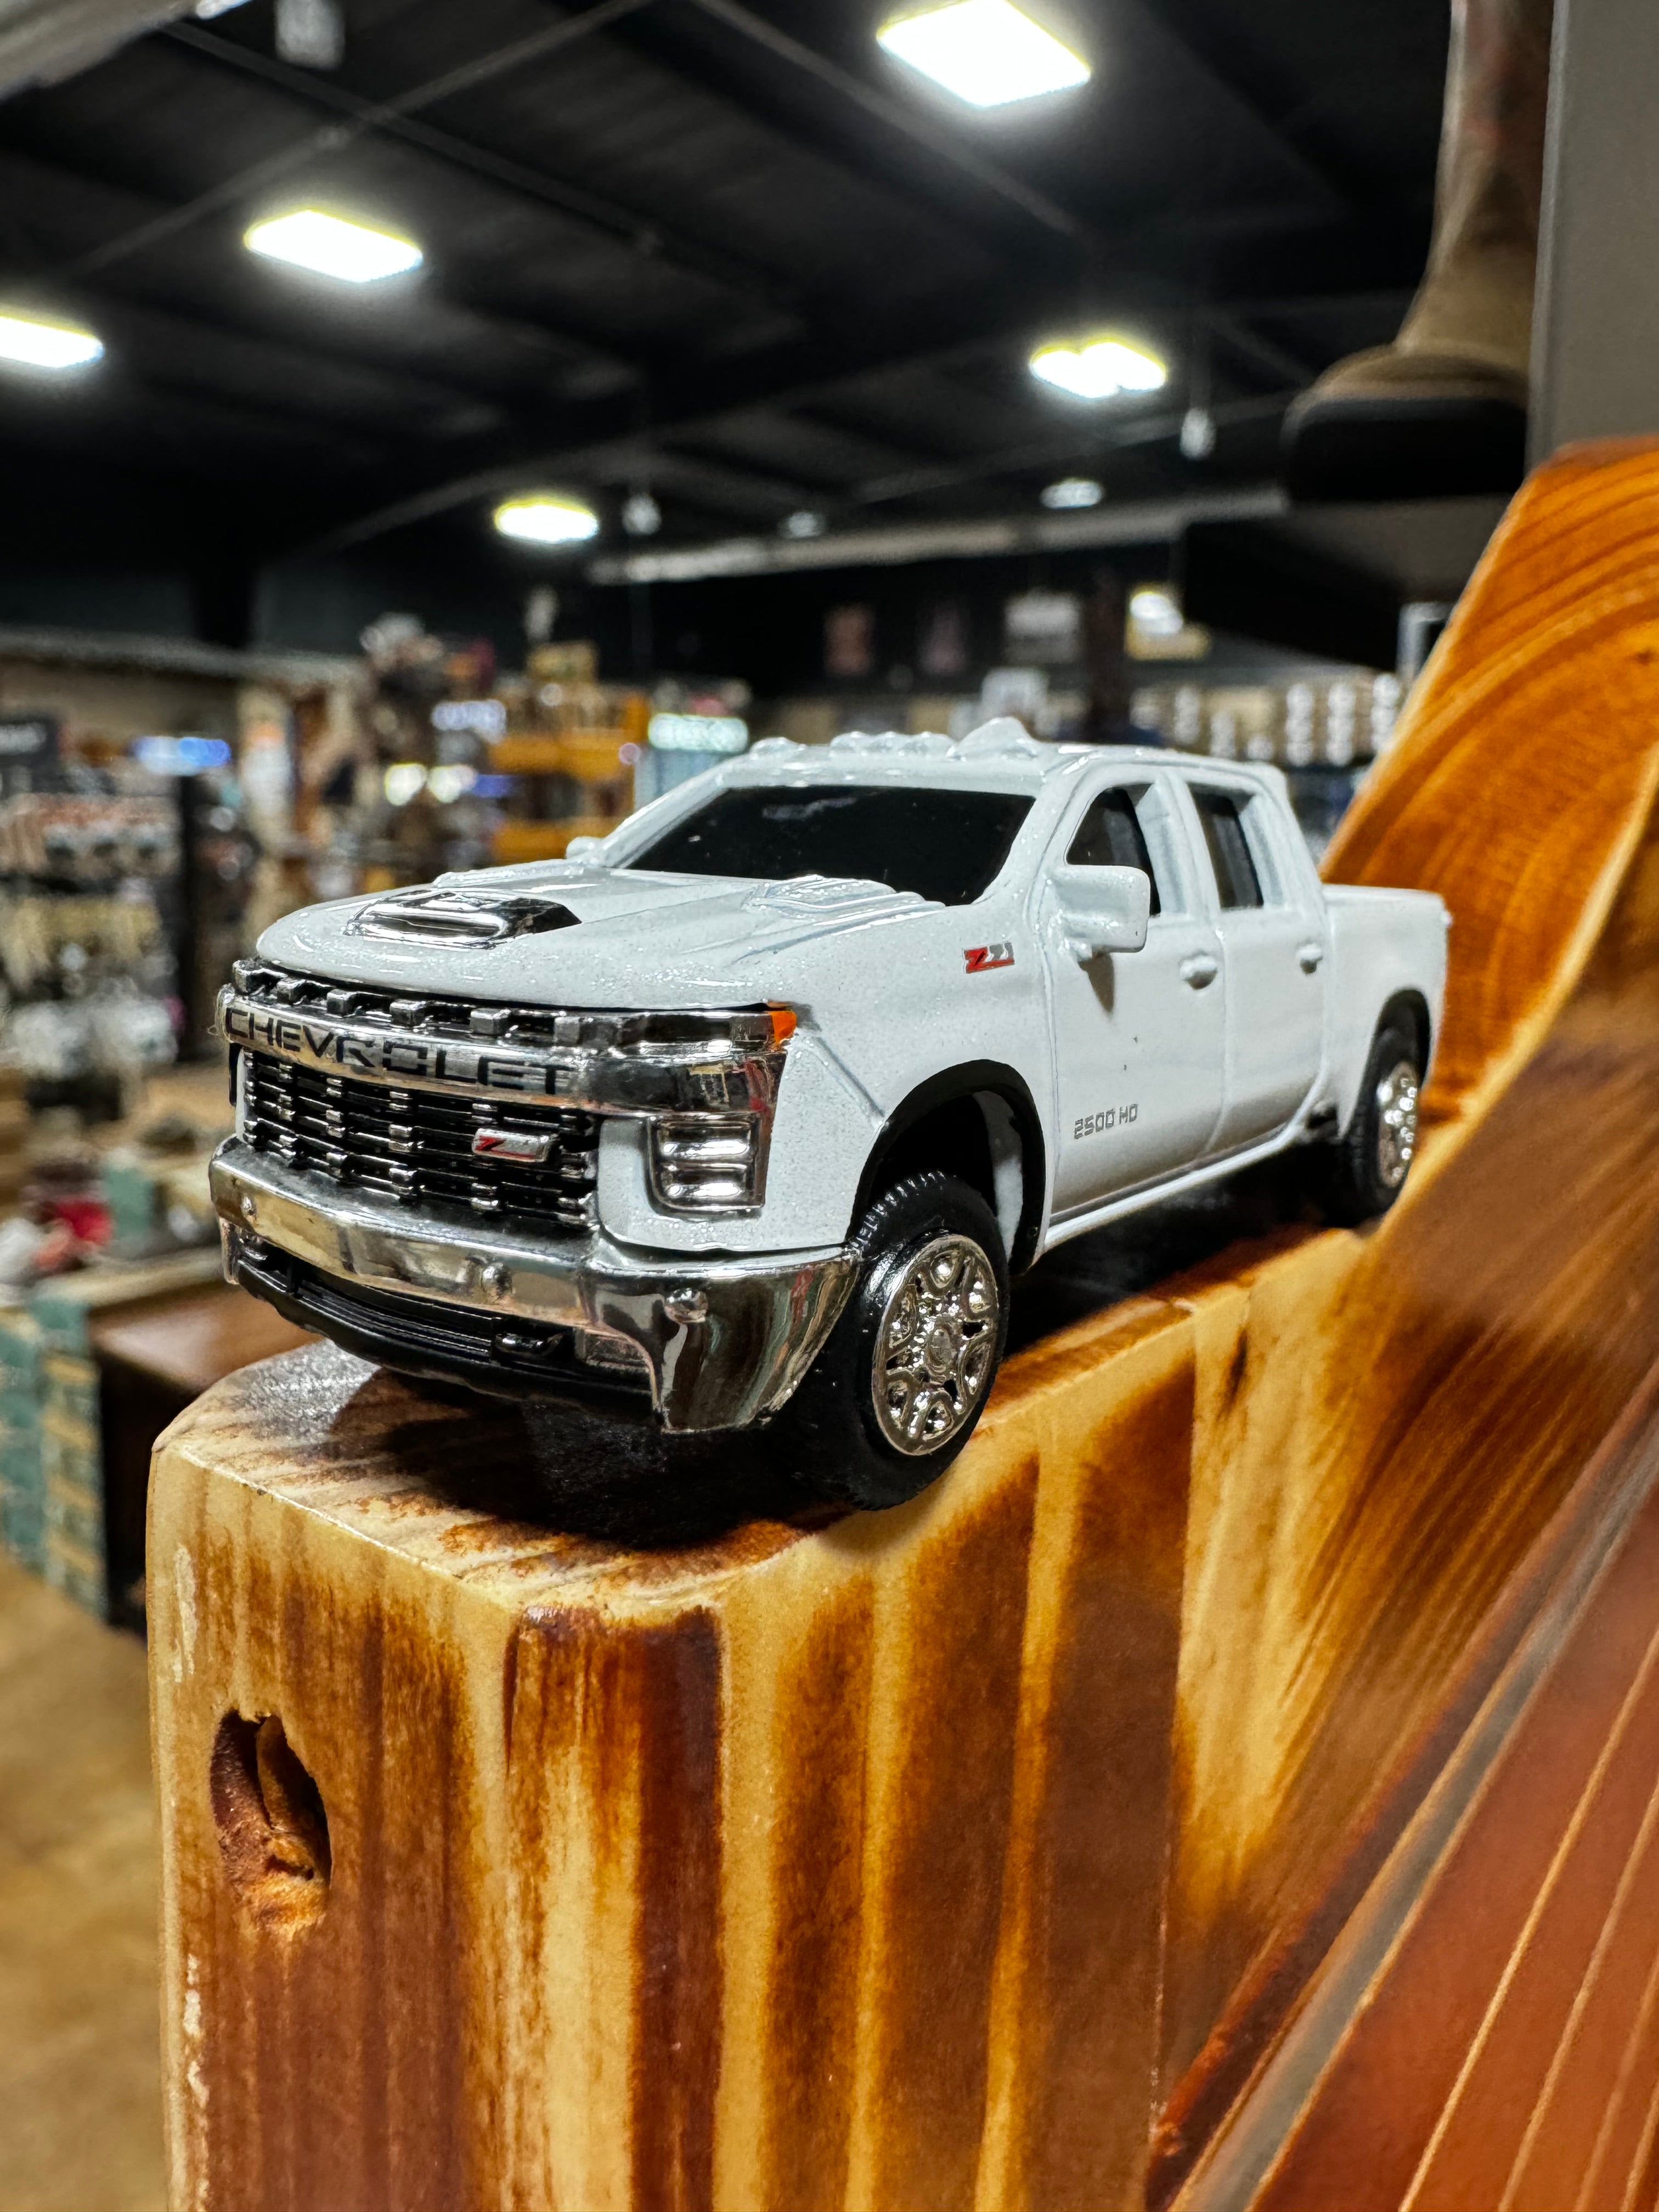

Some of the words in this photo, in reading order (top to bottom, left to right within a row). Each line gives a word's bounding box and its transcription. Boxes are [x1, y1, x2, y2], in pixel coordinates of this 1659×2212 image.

[225, 1007, 576, 1094] CHEVROLET
[1074, 1108, 1115, 1139] 2500
[1119, 1103, 1138, 1125] HD
